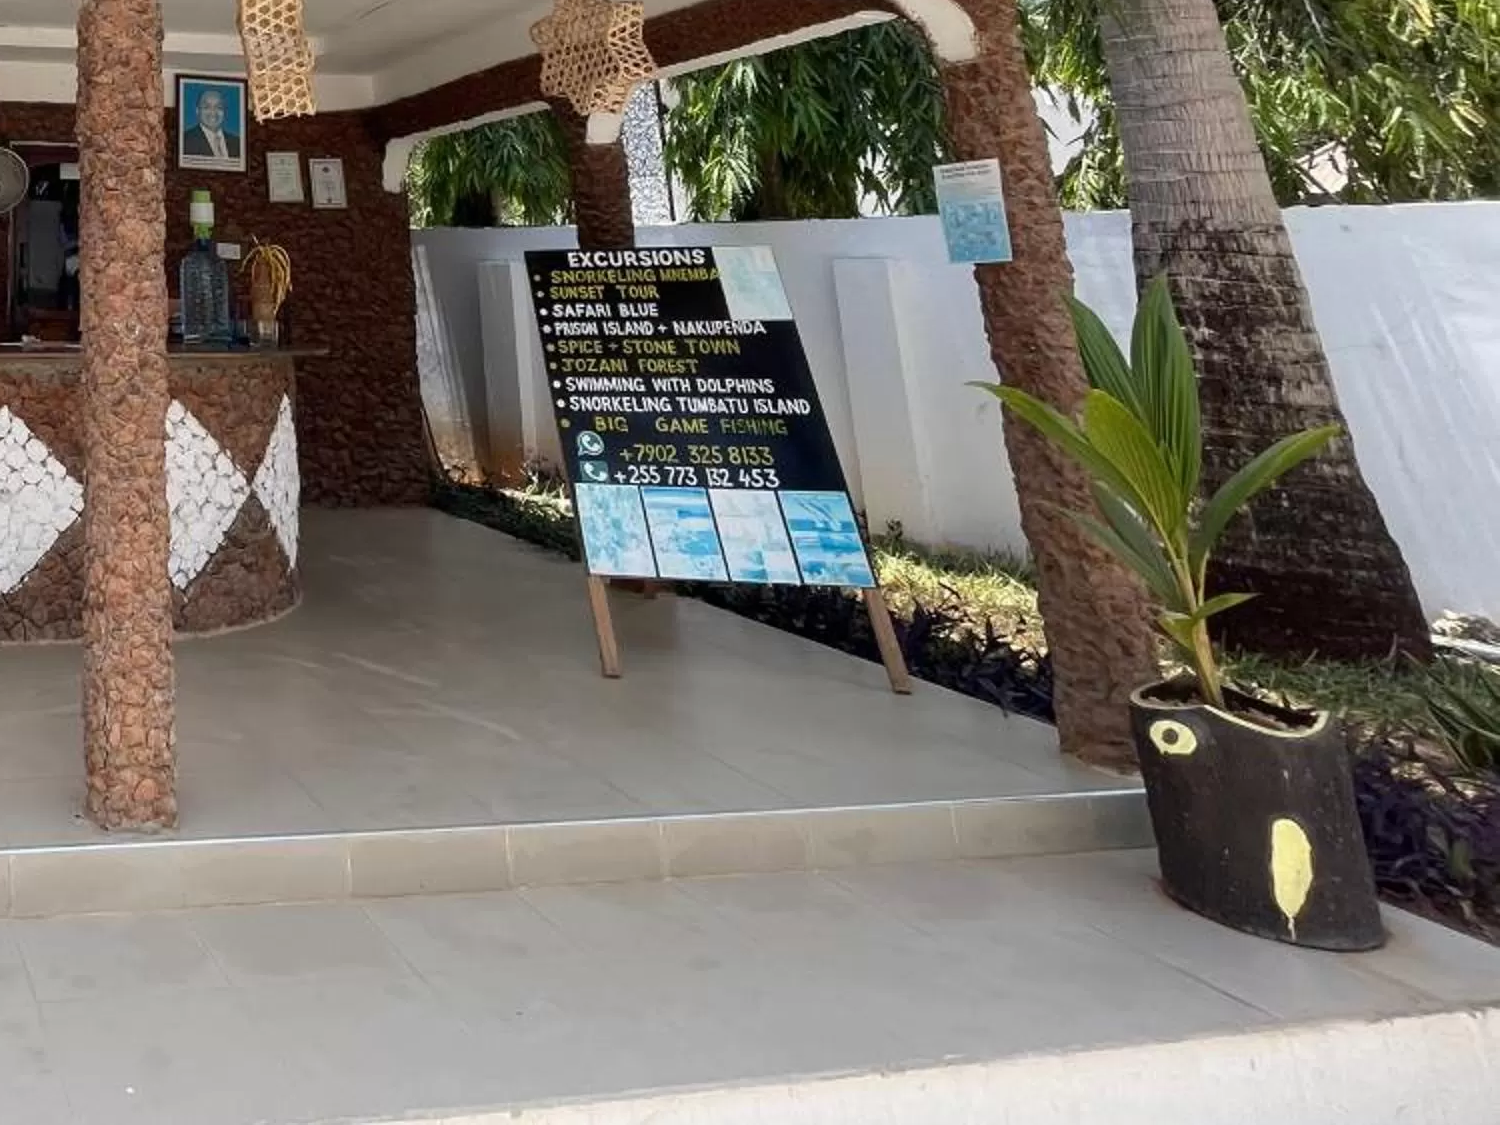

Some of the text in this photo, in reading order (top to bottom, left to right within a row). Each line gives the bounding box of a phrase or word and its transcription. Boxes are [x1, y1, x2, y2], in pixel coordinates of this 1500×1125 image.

[567, 249, 706, 268] EXCURSIONS
[551, 269, 657, 285] SNORKELING
[550, 285, 660, 300] SUNSET TOUR
[552, 302, 659, 318] SAFARI BLUE
[555, 321, 598, 336] PRISON
[603, 321, 653, 336] ISLAND
[673, 320, 767, 336] NAKUPENDA
[557, 340, 603, 355] SPICE
[622, 339, 677, 356] STONE
[684, 339, 741, 355] TOWN
[561, 358, 699, 374] JOZANI FOREST
[565, 377, 775, 394] SWIMMING WITH DOLPHINS
[569, 396, 811, 415] SNORKELING TUMBATU ISLAND
[594, 416, 788, 436] BIG GAME FISHING
[619, 444, 775, 465] +7902 325 8133
[614, 465, 781, 488] +255 773 132 453
